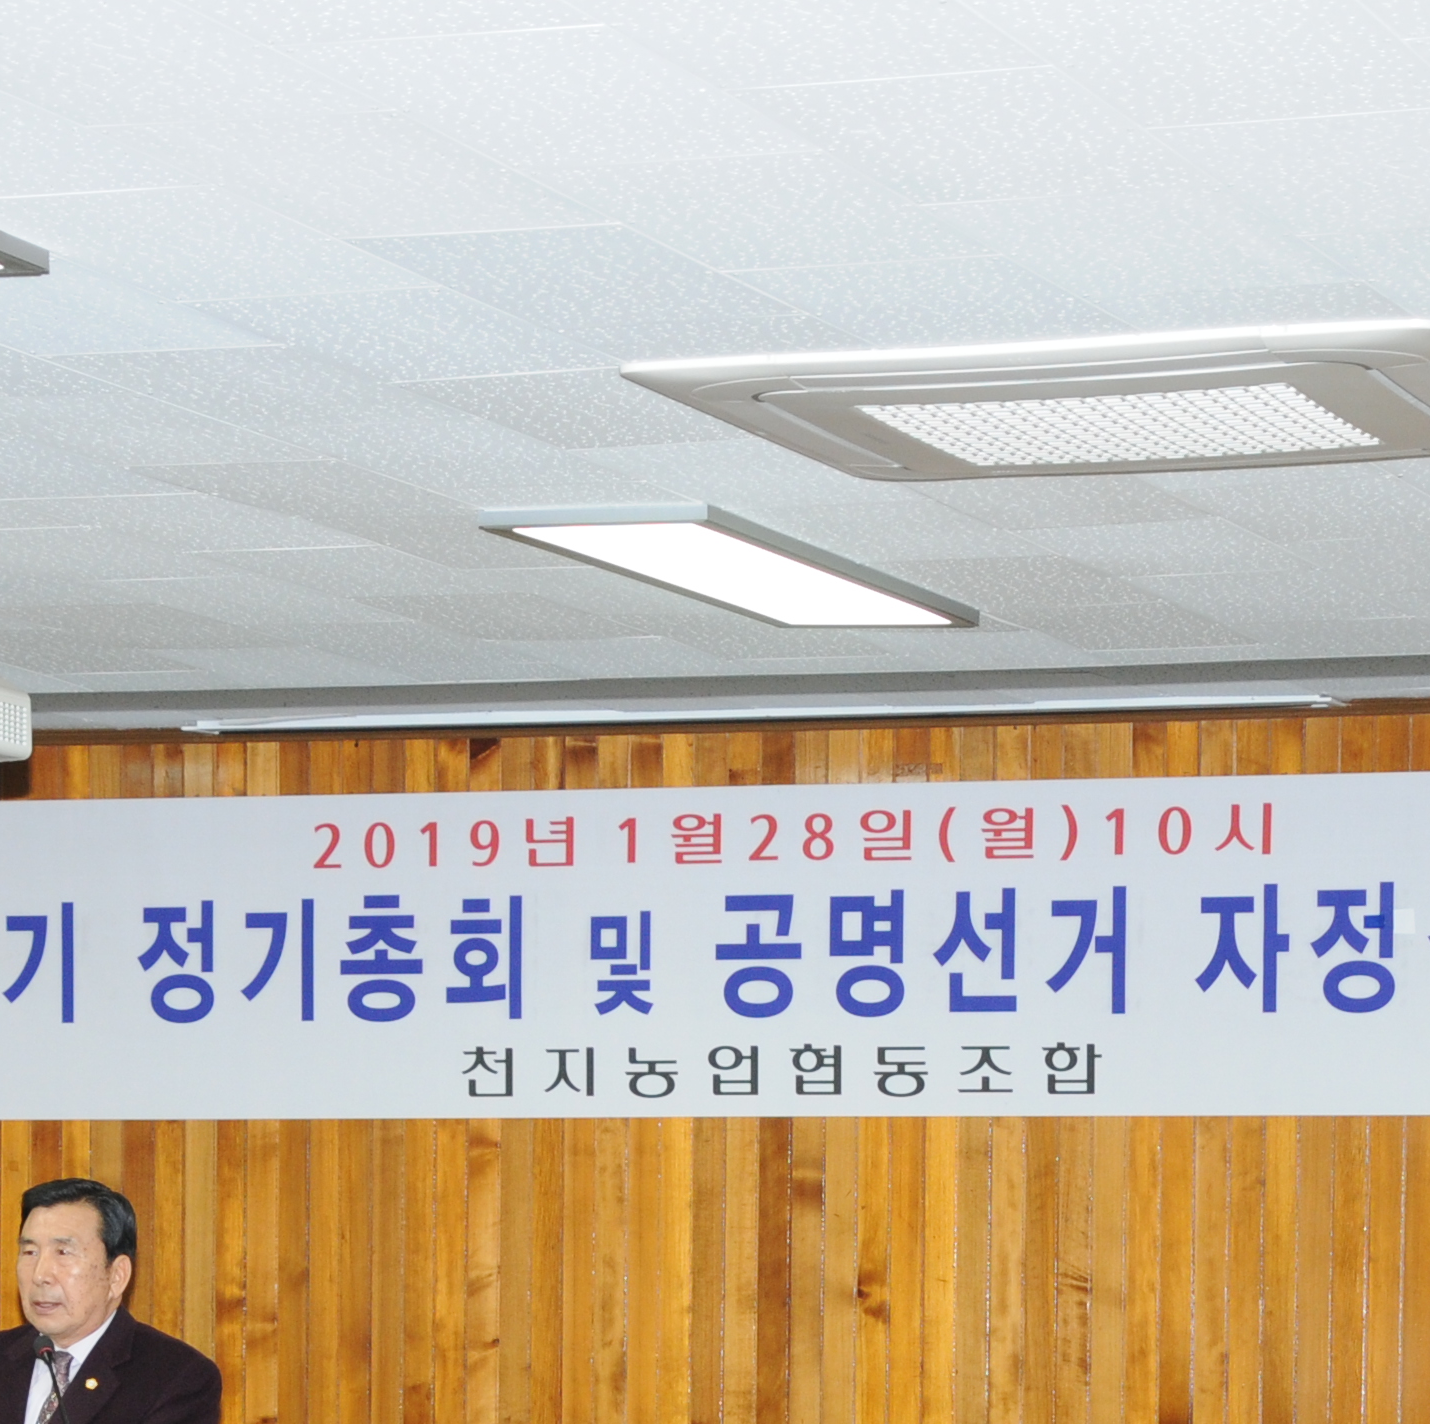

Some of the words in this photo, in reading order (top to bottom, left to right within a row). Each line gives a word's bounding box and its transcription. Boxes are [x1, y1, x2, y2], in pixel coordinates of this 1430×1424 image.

[313, 816, 576, 869] 2019년
[138, 895, 522, 1023] 정기총회
[589, 910, 653, 1014] 및
[715, 887, 1127, 1018] 공명선거
[462, 1042, 1103, 1098] 천지농업협동조합
